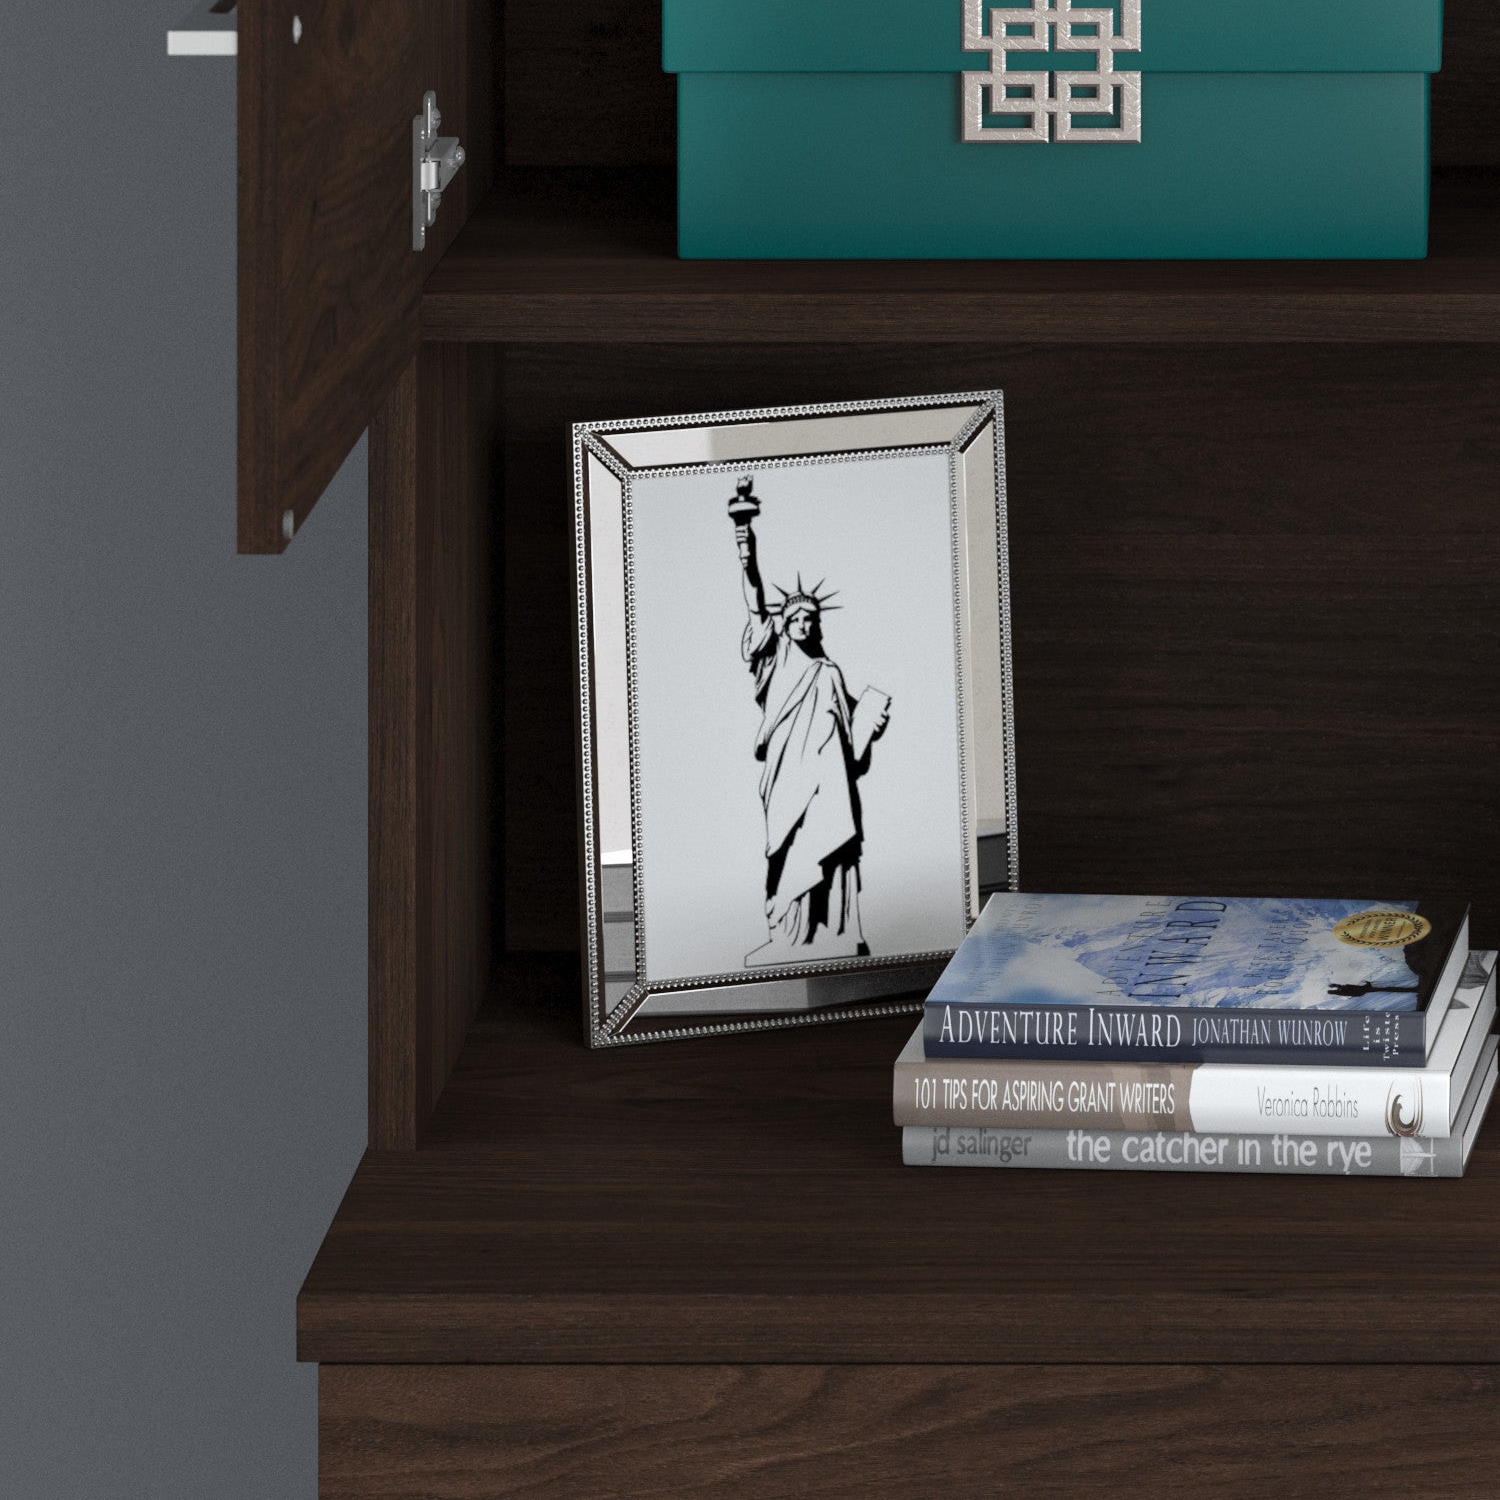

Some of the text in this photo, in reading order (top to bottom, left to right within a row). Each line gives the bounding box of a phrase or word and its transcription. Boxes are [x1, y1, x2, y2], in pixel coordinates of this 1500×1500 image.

[1096, 900, 1171, 997] ADVENTURE
[1128, 901, 1228, 998] INWARD
[939, 1004, 1348, 1047] ADVENTURE INWARD JONATHAN WUNROW
[914, 1078, 1175, 1114] 101 TIPS FOR ASPIRING GRANT WRITERS
[1257, 1084, 1359, 1118] Veronica Robbins
[931, 1127, 1032, 1163] jd salinger
[1066, 1130, 1372, 1175] the catcher in the rye
